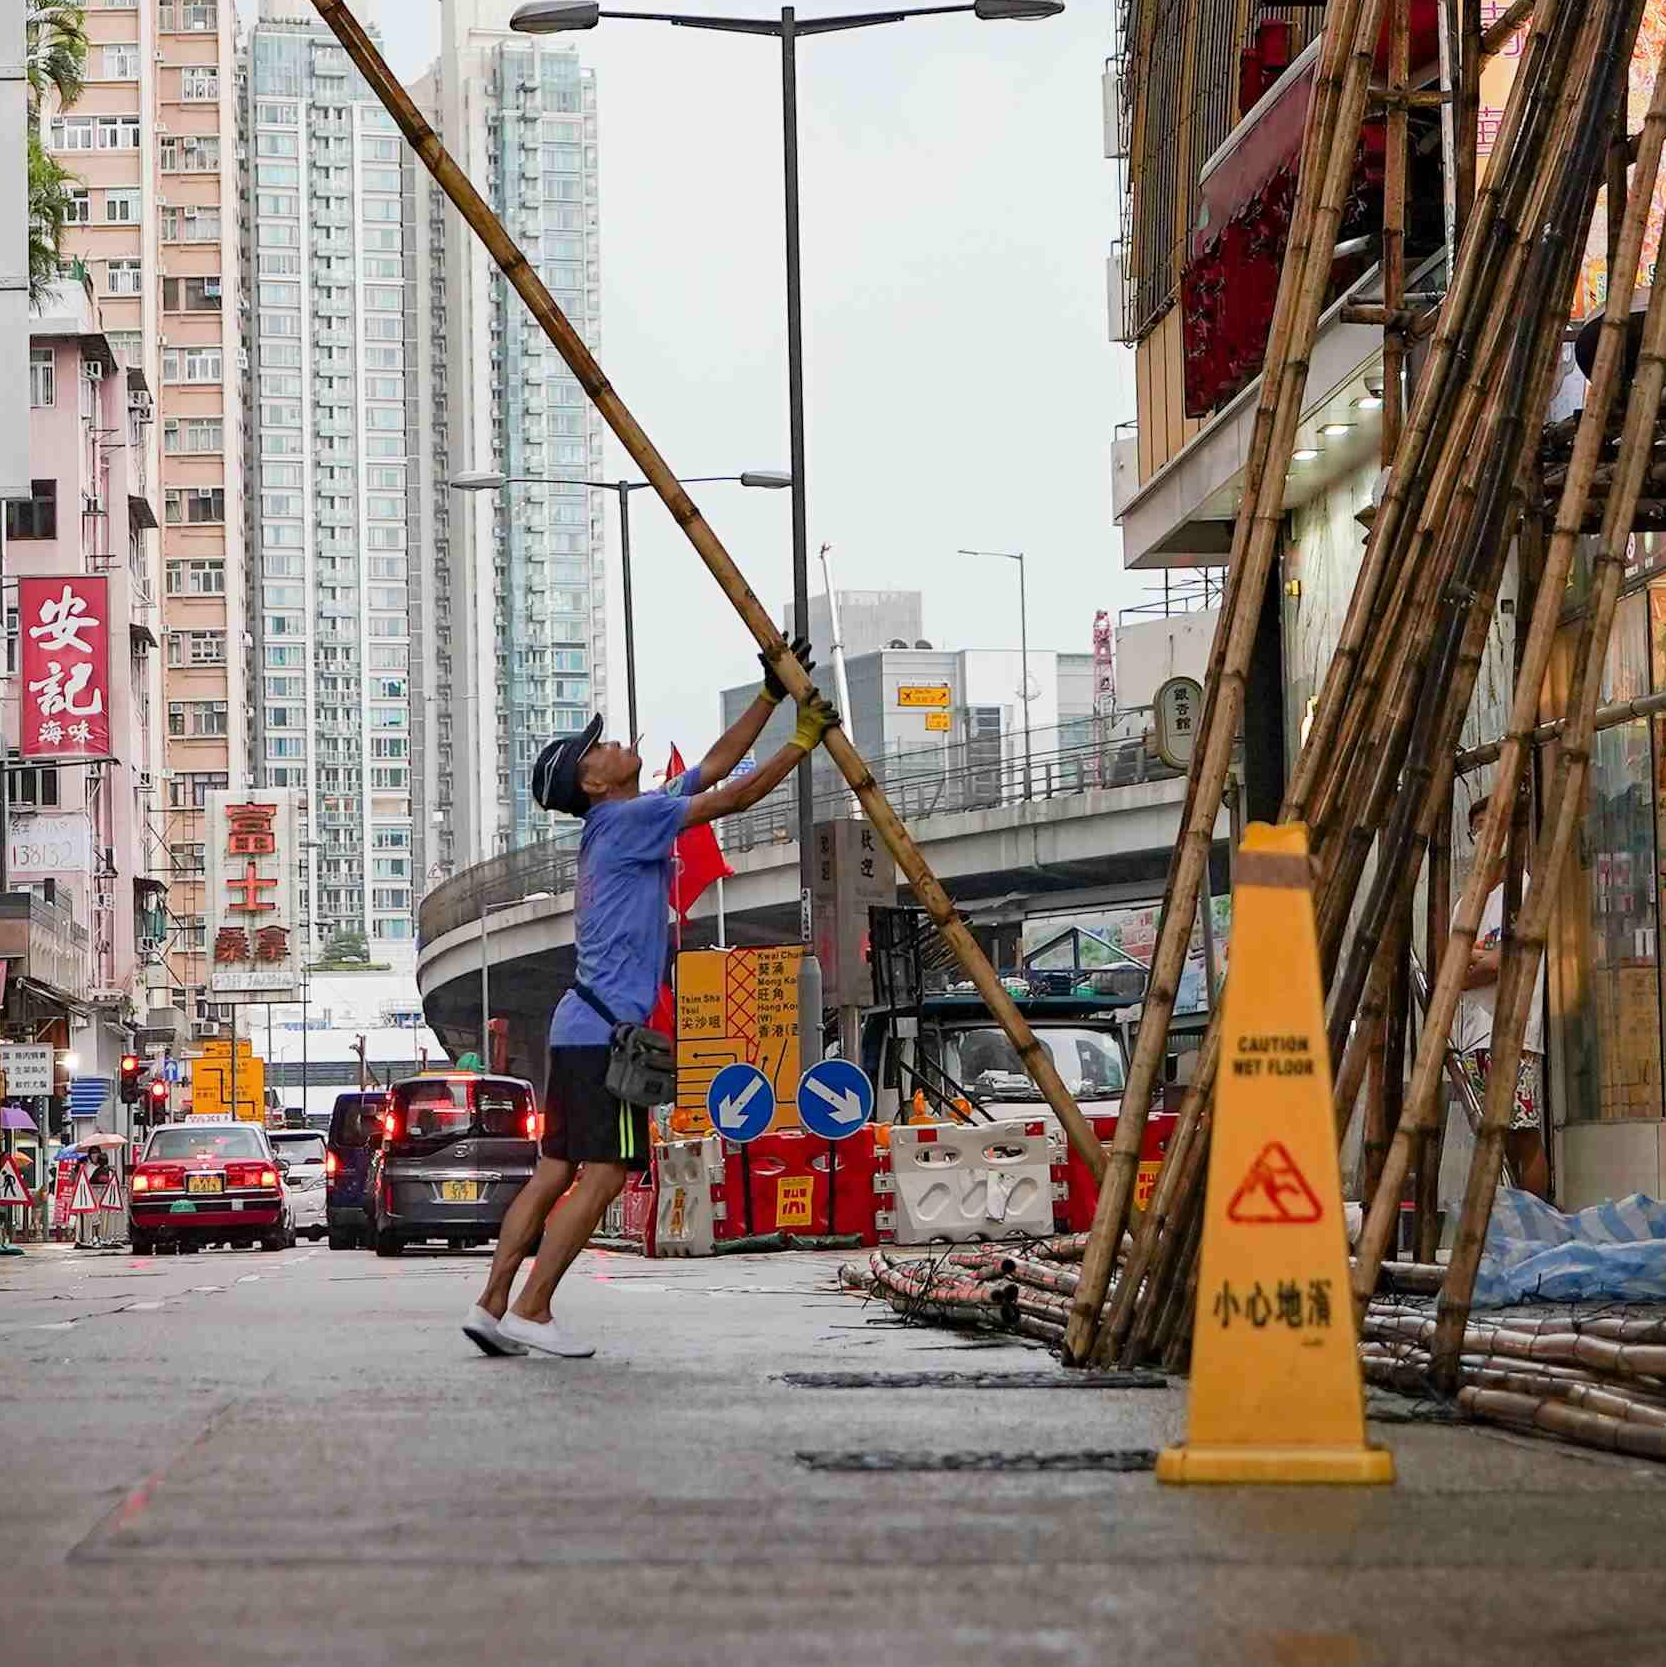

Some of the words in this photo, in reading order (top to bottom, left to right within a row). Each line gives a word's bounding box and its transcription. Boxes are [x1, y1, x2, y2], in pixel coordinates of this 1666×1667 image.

[28, 584, 103, 716] 安記
[1174, 687, 1191, 730] 銀杏館
[38, 719, 94, 746] 海味
[224, 801, 278, 911] 富士
[215, 925, 292, 962] 桑拿
[757, 951, 779, 960] Kwai
[758, 963, 785, 976] 葵涌
[757, 978, 781, 988] Mong
[681, 995, 701, 1004] Tsim
[703, 995, 720, 1004] Sha
[757, 988, 784, 1002] 旺角
[681, 1006, 700, 1015] Tsui
[757, 1003, 781, 1013] Hong
[681, 1015, 721, 1030] 尖沙咀
[1238, 1035, 1309, 1057] CAUTION
[1232, 1059, 1261, 1078] WET
[1268, 1059, 1314, 1078] FLOOR
